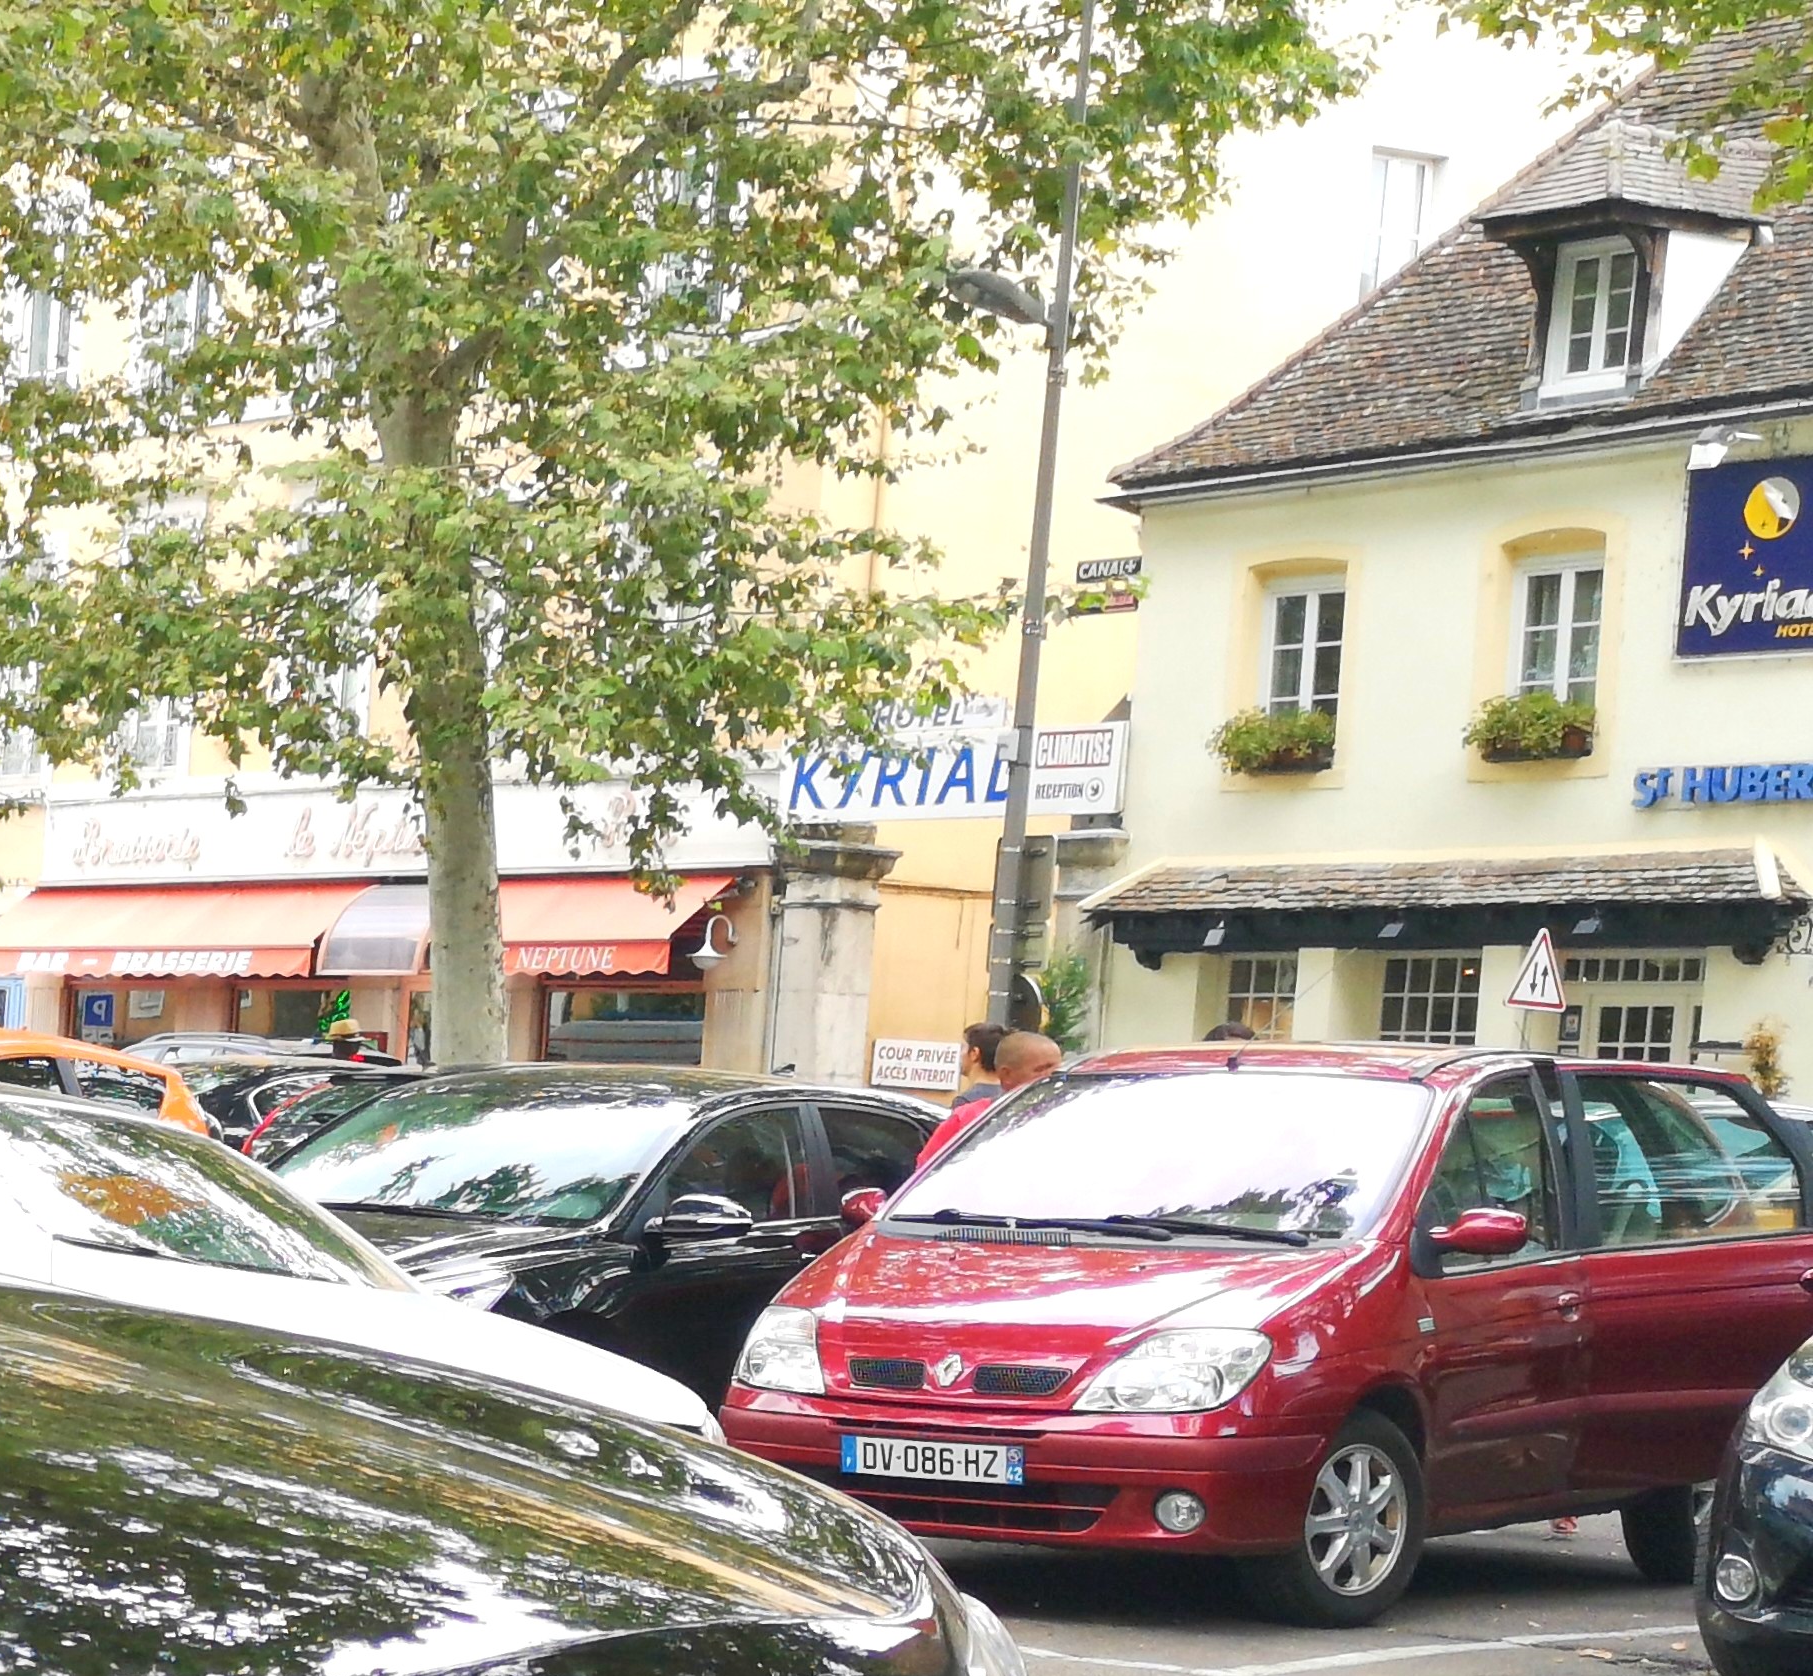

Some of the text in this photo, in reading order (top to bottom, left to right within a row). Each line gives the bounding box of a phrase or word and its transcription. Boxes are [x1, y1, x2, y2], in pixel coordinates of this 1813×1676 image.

[1684, 578, 1813, 636] Kyria
[16, 952, 70, 972] BAR
[110, 951, 253, 972] BRASSERIE
[515, 945, 617, 970] NEPTUNE
[878, 1045, 913, 1061] COUR
[910, 1068, 956, 1084] INTERDIT
[863, 1442, 998, 1478] DV-086-HZ
[1007, 1465, 1023, 1482] 42
